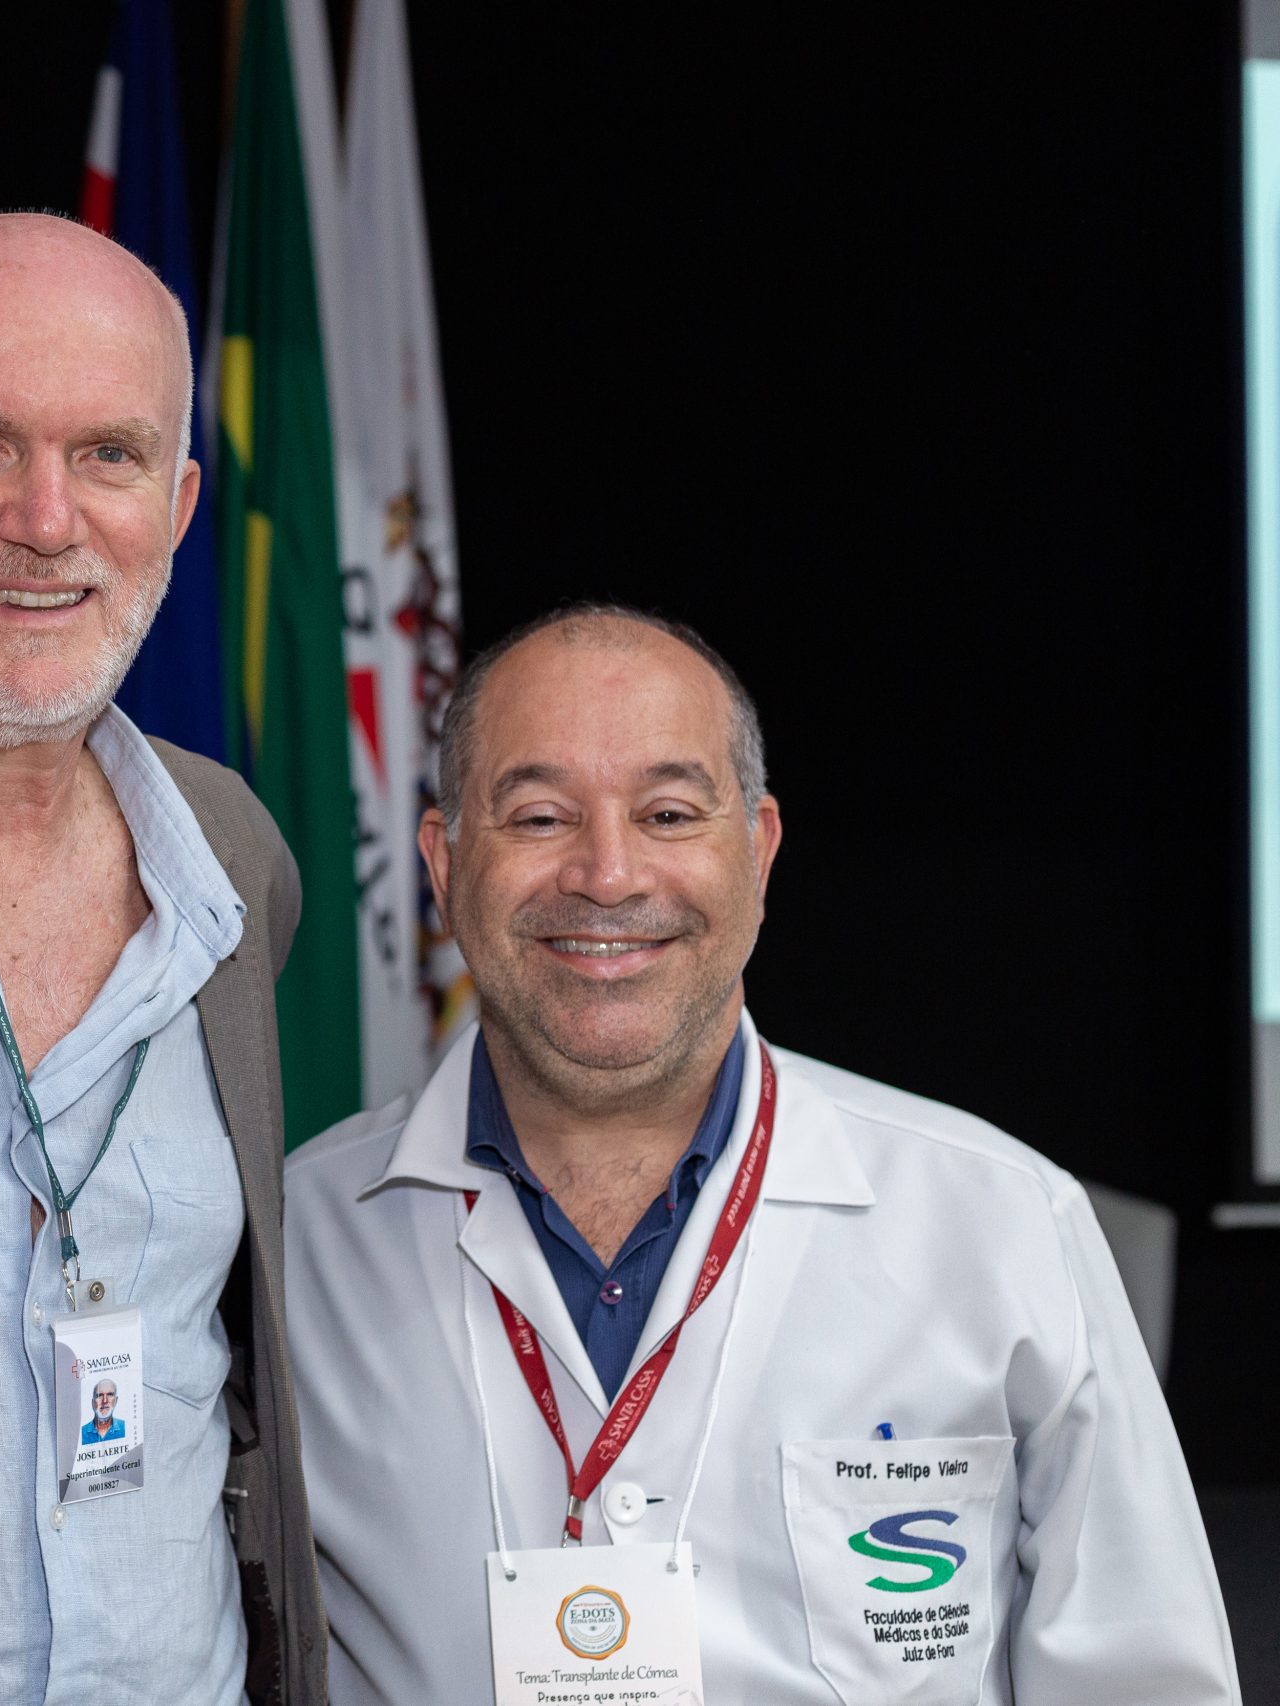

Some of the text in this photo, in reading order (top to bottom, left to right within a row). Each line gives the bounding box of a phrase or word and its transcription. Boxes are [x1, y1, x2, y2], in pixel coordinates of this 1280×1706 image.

[517, 1328, 535, 1354] Mais
[86, 1356, 111, 1370] SANTA
[111, 1353, 132, 1365] CASA
[608, 1402, 638, 1440] SANTA
[630, 1370, 655, 1401] CASA
[77, 1444, 130, 1462] JOSE LAERTE
[66, 1459, 141, 1481] Superintendente Geral
[836, 1459, 968, 1481] Prof. Felipe Vieira
[88, 1480, 120, 1493] 00018827
[570, 1607, 615, 1619] E-DOTS
[864, 1602, 970, 1625] Faculdade de Ciências
[873, 1620, 969, 1643] Médicas e da Saúde
[902, 1644, 955, 1662] Juiz de Fora
[515, 1664, 679, 1686] Tema: Transplante de Córnea
[537, 1690, 660, 1704] Presença que inspira.
